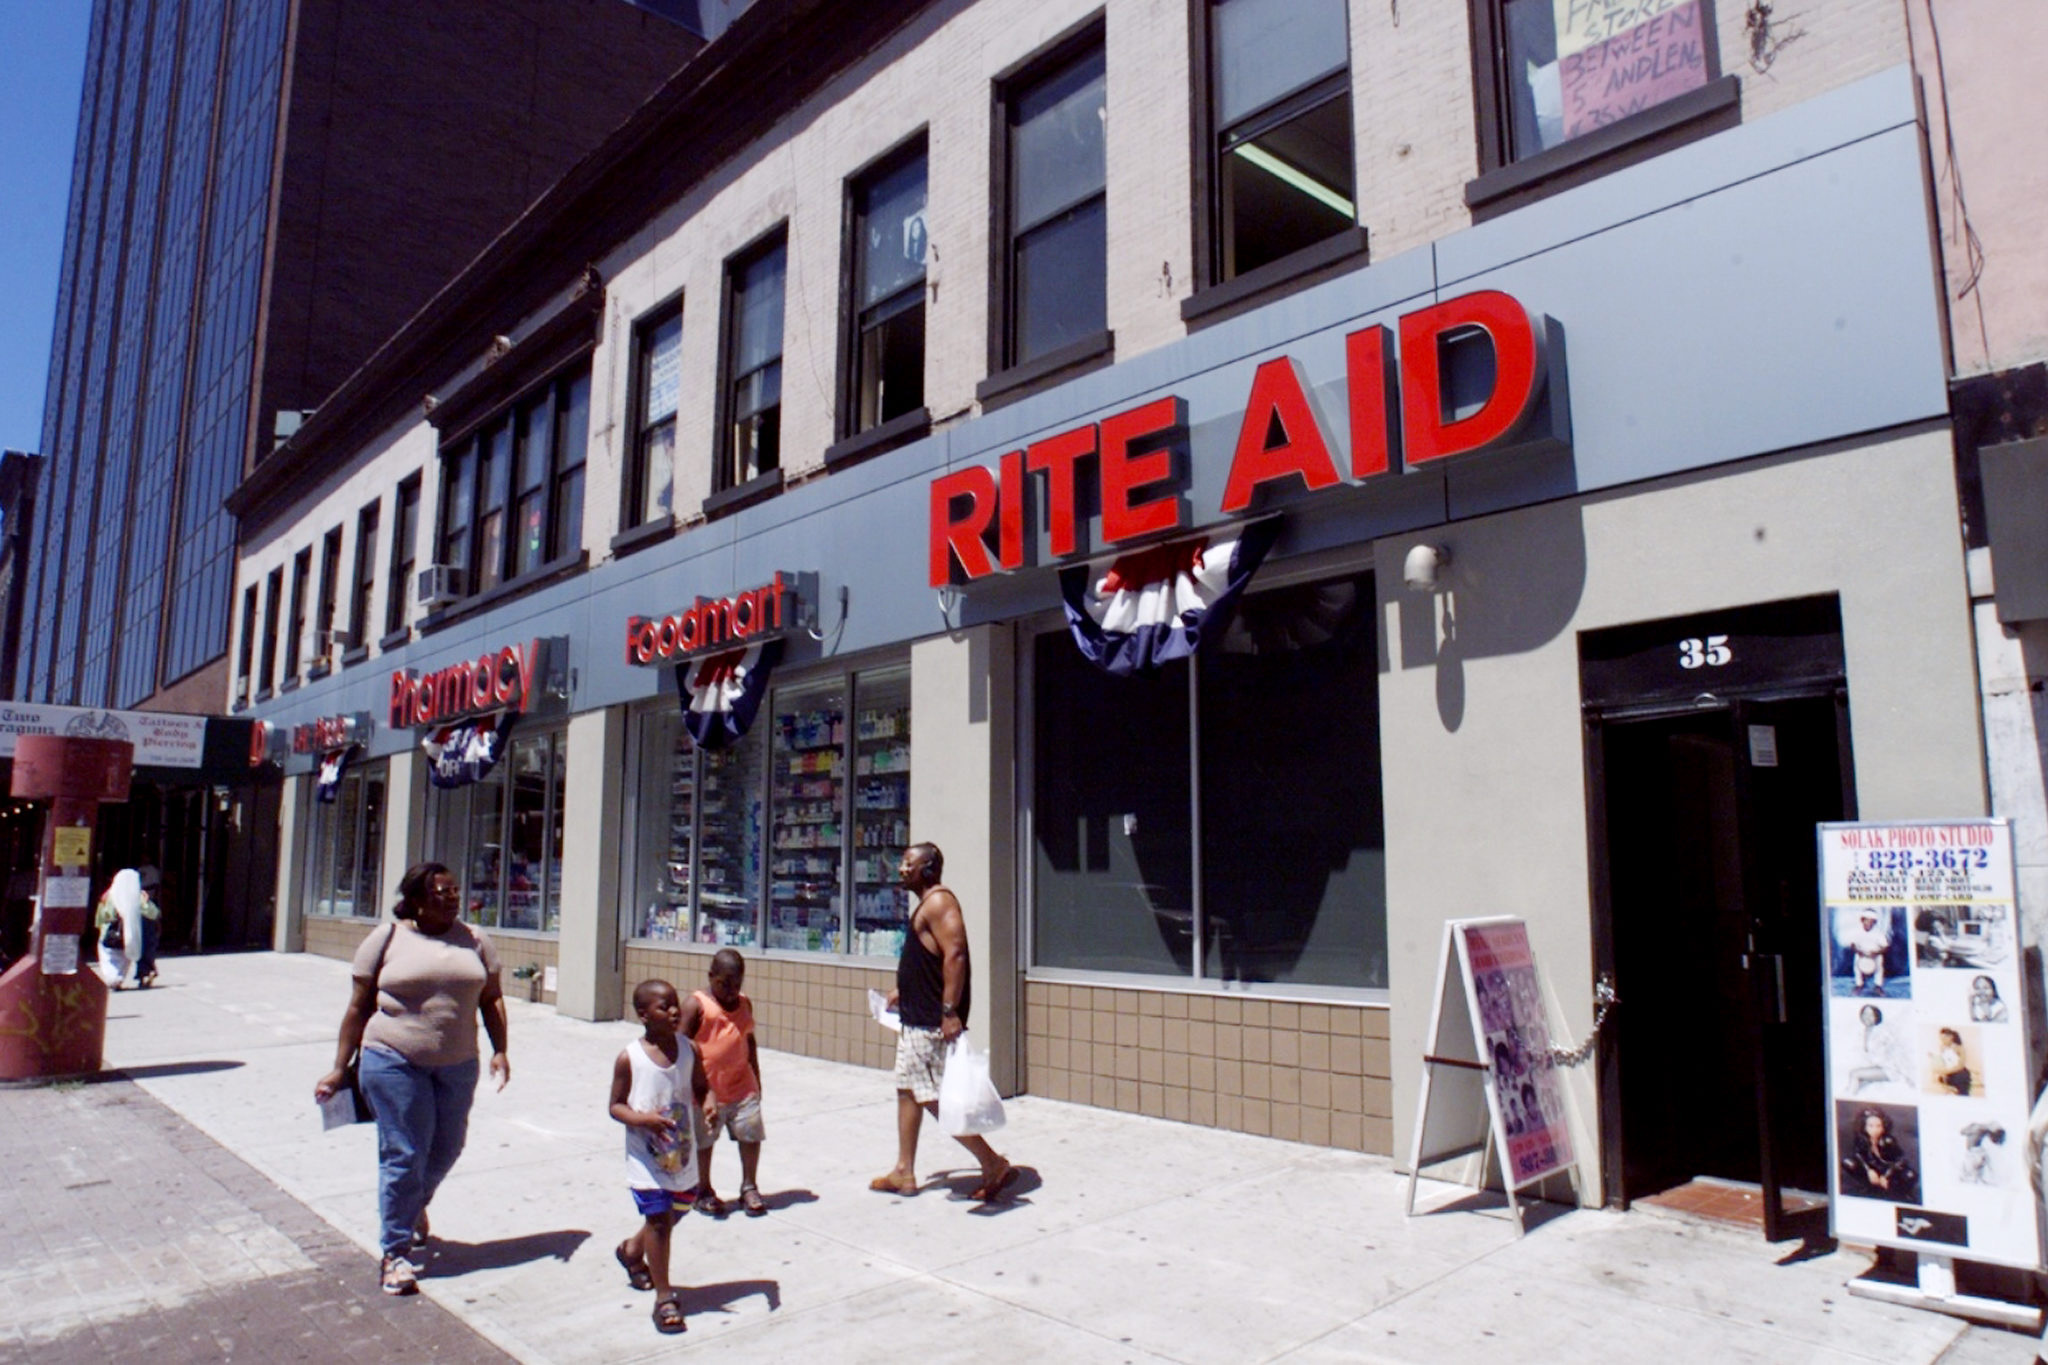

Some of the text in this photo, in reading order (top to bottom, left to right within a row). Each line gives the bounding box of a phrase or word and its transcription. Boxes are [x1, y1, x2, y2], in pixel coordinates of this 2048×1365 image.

[1565, 4, 1695, 88] BETWEEN
[929, 289, 1540, 588] RITE AID
[626, 570, 787, 666] Foodmart
[1679, 635, 1732, 669] 35
[389, 637, 540, 730] Pharmacy
[0, 723, 56, 736] ragons
[1869, 848, 1988, 869] 828-3672
[1888, 826, 1936, 847] PHOTO
[1940, 825, 1993, 847] STUDIO
